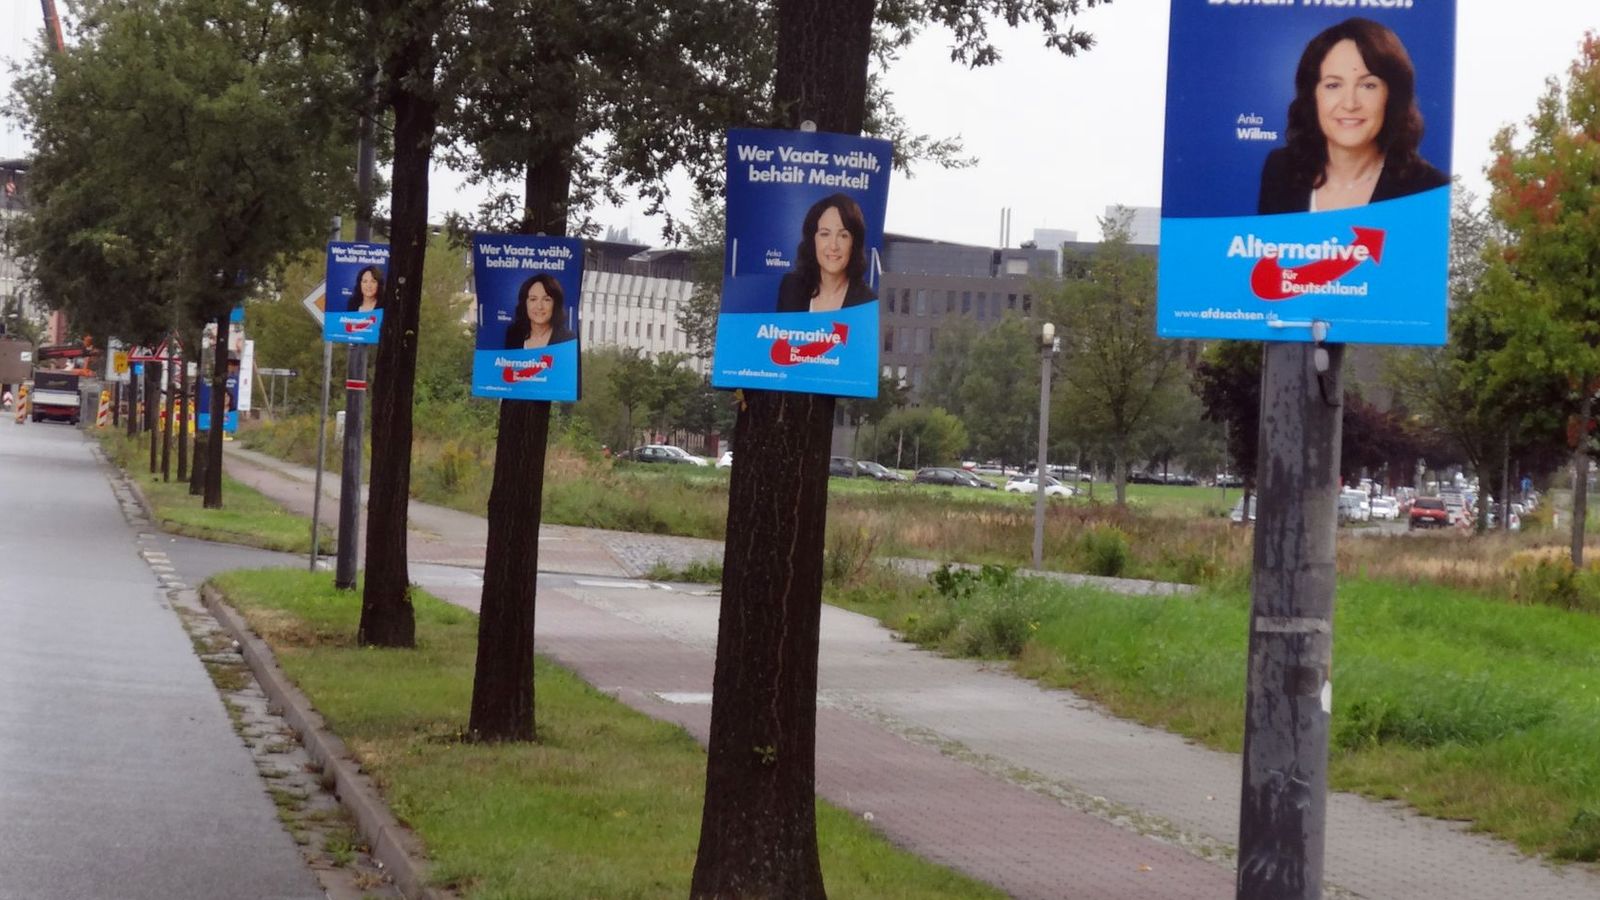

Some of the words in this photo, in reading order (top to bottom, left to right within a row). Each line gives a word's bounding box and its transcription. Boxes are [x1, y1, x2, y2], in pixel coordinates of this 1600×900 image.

[1237, 112, 1264, 125] Anka
[1236, 127, 1278, 140] Willms
[738, 145, 775, 162] Wer
[778, 146, 829, 165] Vaatz
[833, 151, 881, 173] wählt,
[749, 164, 805, 184] behält
[808, 168, 870, 190] Merkel!
[479, 244, 501, 255] Wer
[503, 244, 535, 257] Vaatz
[538, 246, 573, 259] wählt,
[1227, 234, 1370, 262] Alternative
[486, 256, 520, 269] behält
[521, 258, 565, 271] Merkel!
[1282, 268, 1298, 281] für
[1281, 280, 1368, 297] Deutschland
[756, 324, 842, 344] Alternative
[494, 356, 548, 369] Alternative
[790, 353, 839, 367] Deutschland
